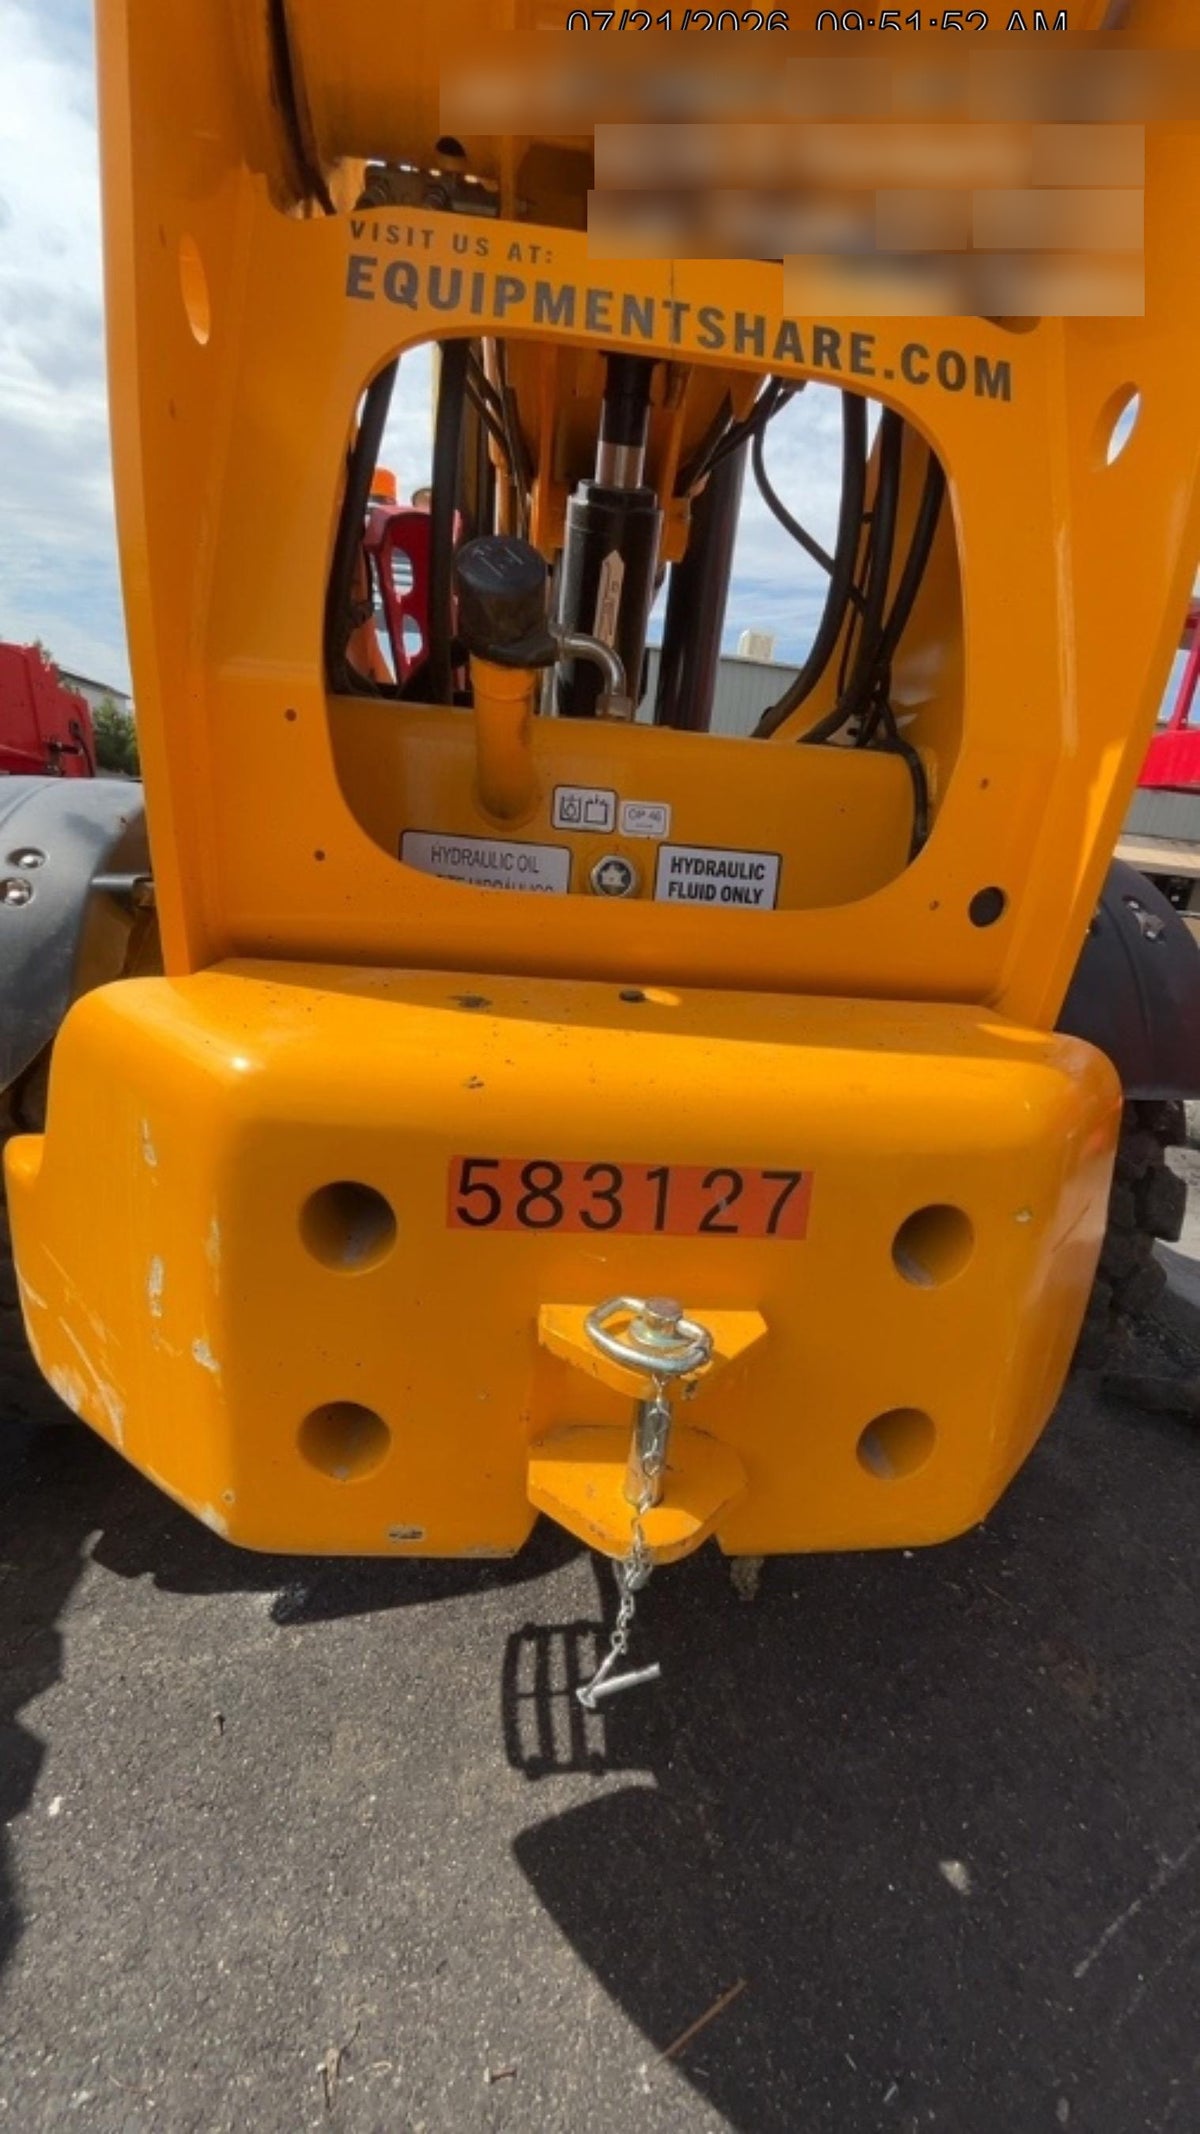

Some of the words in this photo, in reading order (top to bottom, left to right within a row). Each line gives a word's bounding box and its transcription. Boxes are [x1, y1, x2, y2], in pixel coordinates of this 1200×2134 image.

[350, 220, 434, 250] VISIT
[452, 233, 489, 256] US
[507, 241, 553, 265] AT:
[345, 254, 1012, 402] EQUIPMENTSHARE.COM
[430, 845, 514, 871] HYDRAULIC
[516, 854, 541, 874] OIL
[670, 855, 766, 881] HYDRAULIC
[667, 881, 717, 901] FLUID
[720, 884, 764, 905] ONLY
[455, 1157, 803, 1235] 583127
